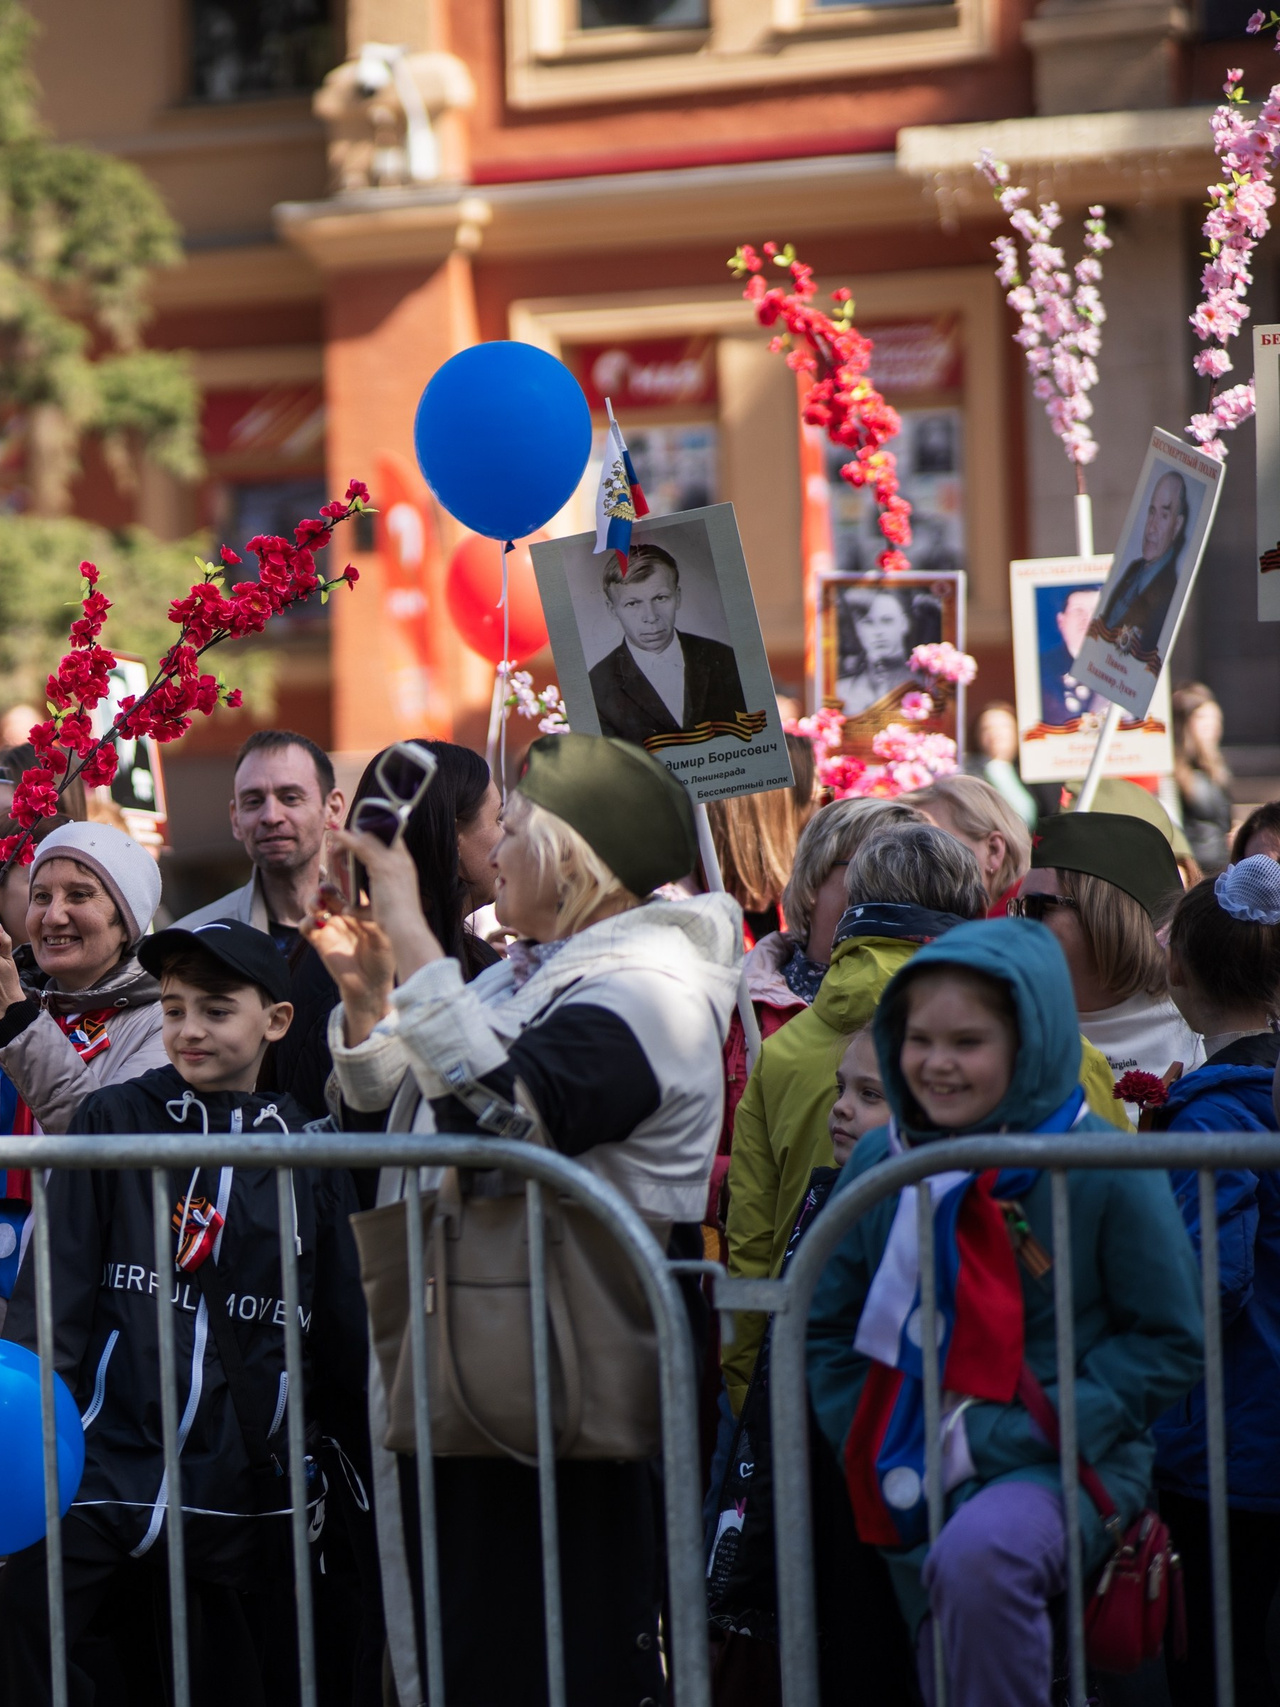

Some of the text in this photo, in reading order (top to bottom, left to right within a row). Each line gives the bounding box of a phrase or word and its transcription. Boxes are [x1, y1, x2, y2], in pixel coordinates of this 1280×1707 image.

[708, 742, 777, 763] Борисович
[691, 767, 746, 784] Ленинграда
[697, 779, 764, 799] Бессмертный
[766, 775, 789, 786] полк
